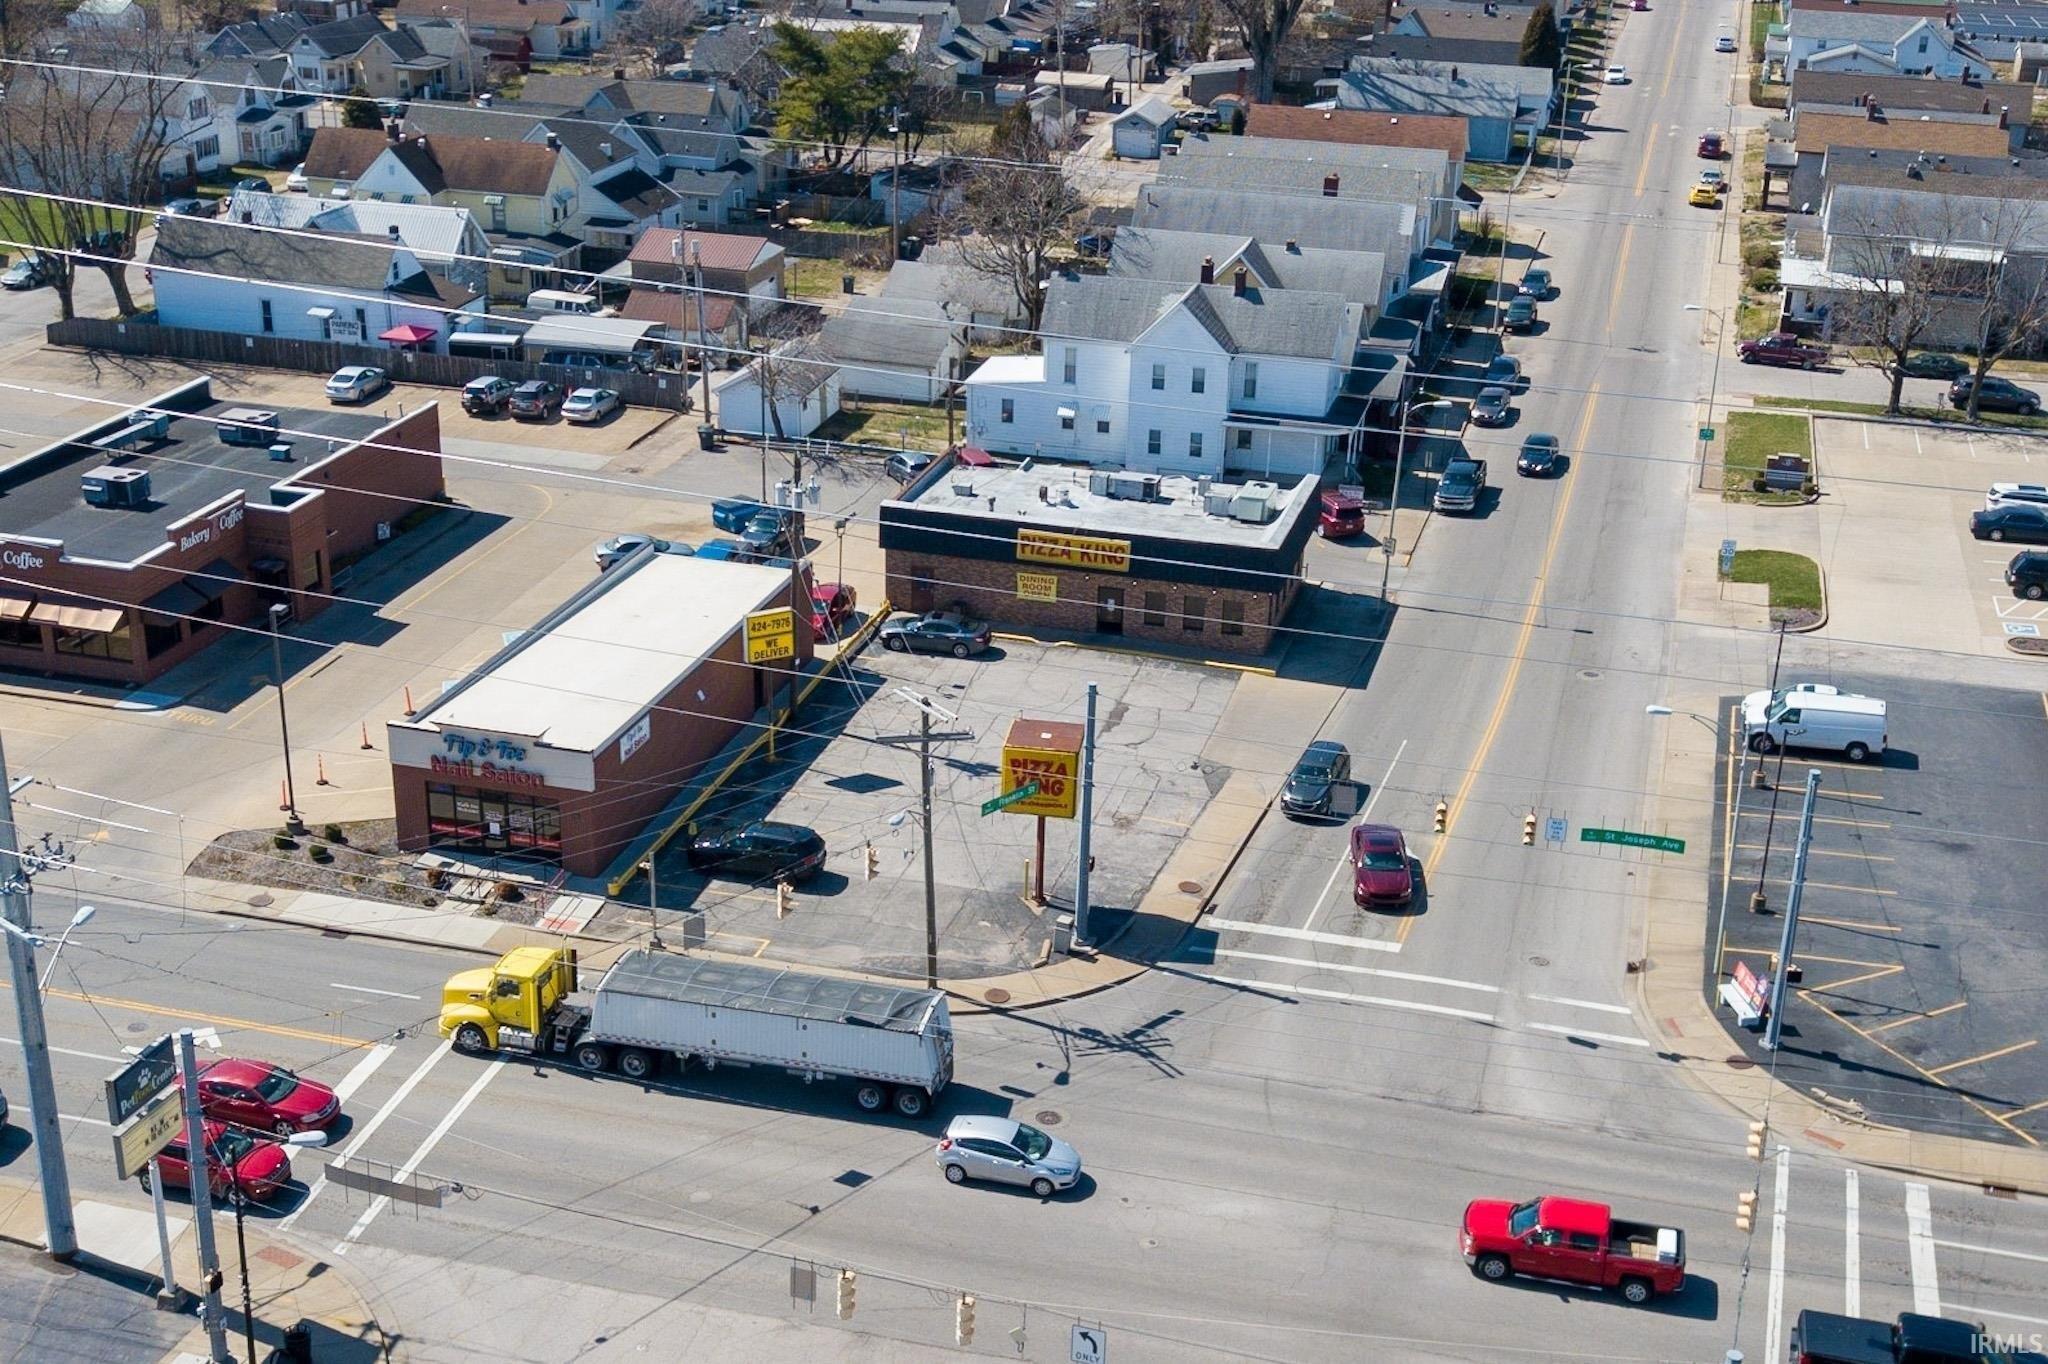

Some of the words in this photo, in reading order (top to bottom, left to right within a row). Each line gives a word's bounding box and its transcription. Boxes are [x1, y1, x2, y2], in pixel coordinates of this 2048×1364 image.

[180, 527, 210, 552] Bakery
[219, 508, 244, 530] Coffee
[1020, 535, 1072, 560] PIZZA
[1080, 543, 1125, 566] KING
[3, 550, 44, 570] Coffee
[1020, 575, 1055, 584] DINING
[1023, 583, 1051, 592] ROOM
[764, 638, 778, 648] WE
[754, 646, 790, 660] DELIVER
[443, 733, 476, 758] Tip
[496, 740, 527, 762] Toe
[431, 754, 474, 778] Nail
[480, 761, 544, 787] Salon
[1010, 758, 1067, 776] PIZZA
[1604, 832, 1615, 840] St
[1623, 835, 1656, 846] Joseph
[1662, 840, 1680, 850] Ave
[1075, 1351, 1101, 1362] ONLY
